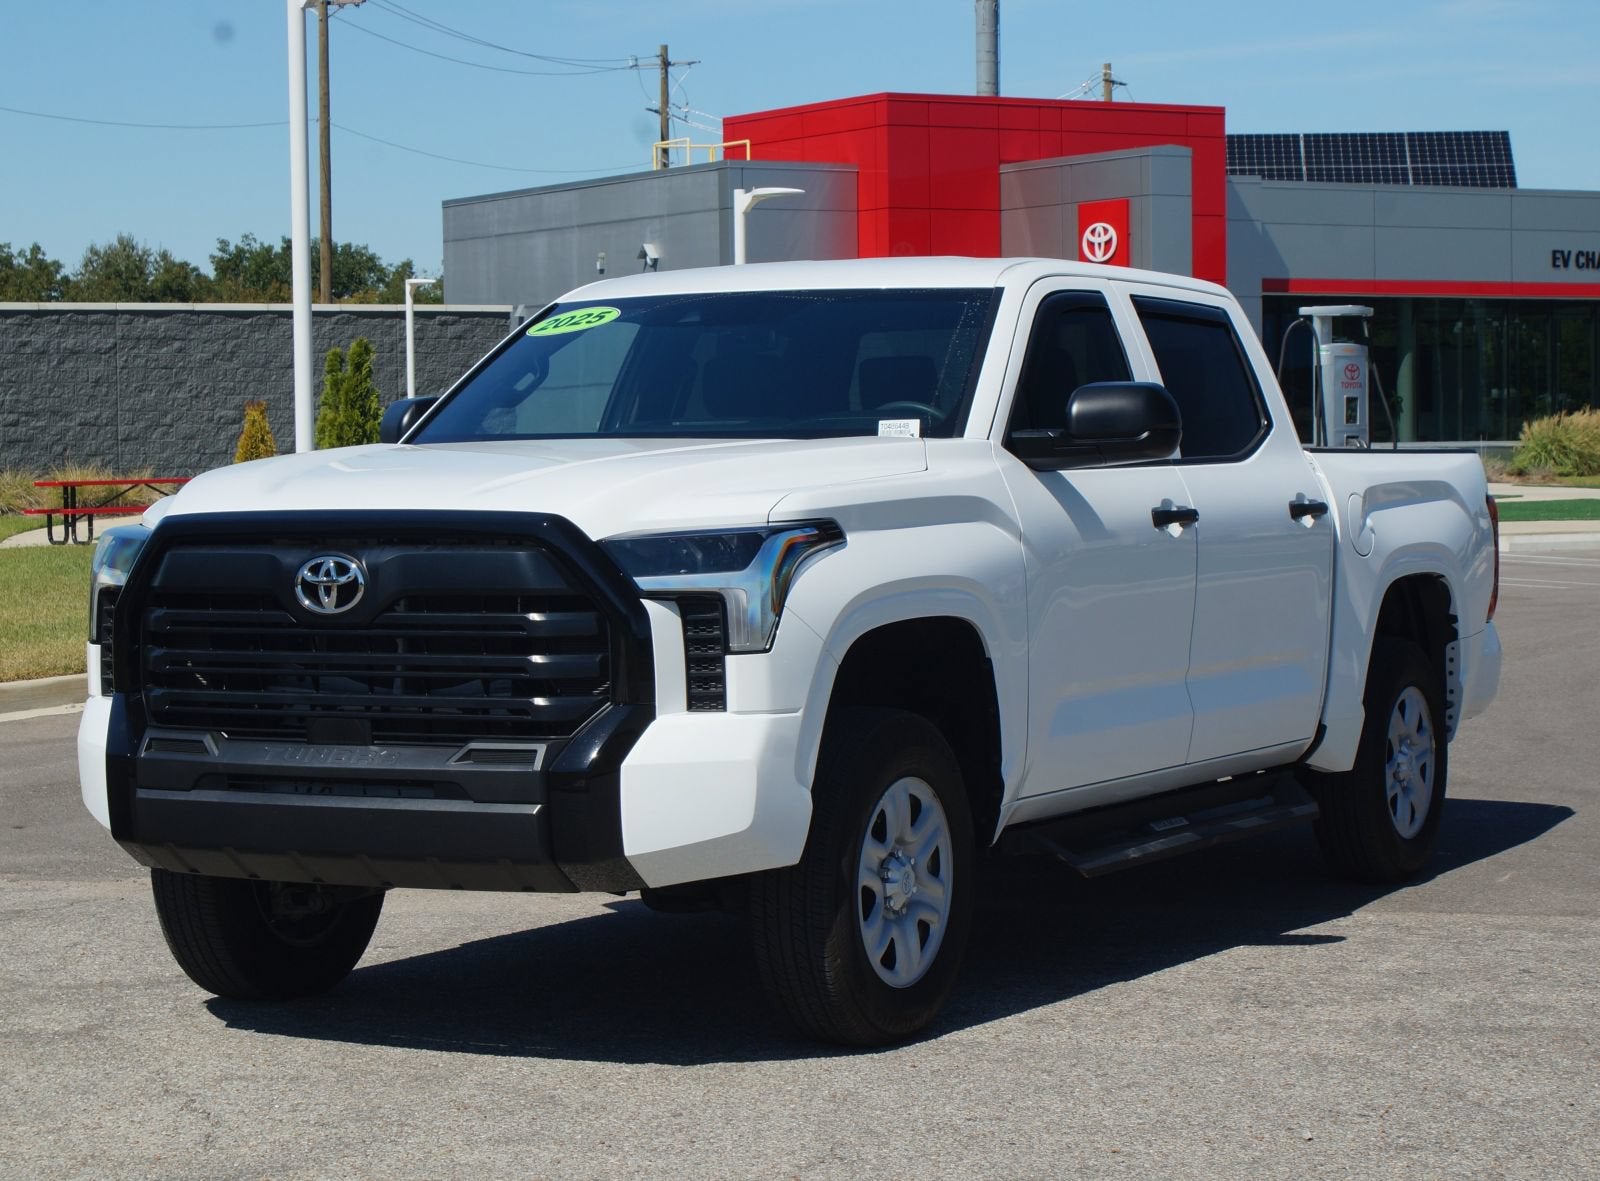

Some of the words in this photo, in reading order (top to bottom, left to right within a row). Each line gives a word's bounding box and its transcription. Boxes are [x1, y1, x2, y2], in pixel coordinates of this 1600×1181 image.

[1552, 250, 1571, 268] EV
[533, 310, 613, 333] 2025
[1341, 381, 1362, 389] TOYOTA
